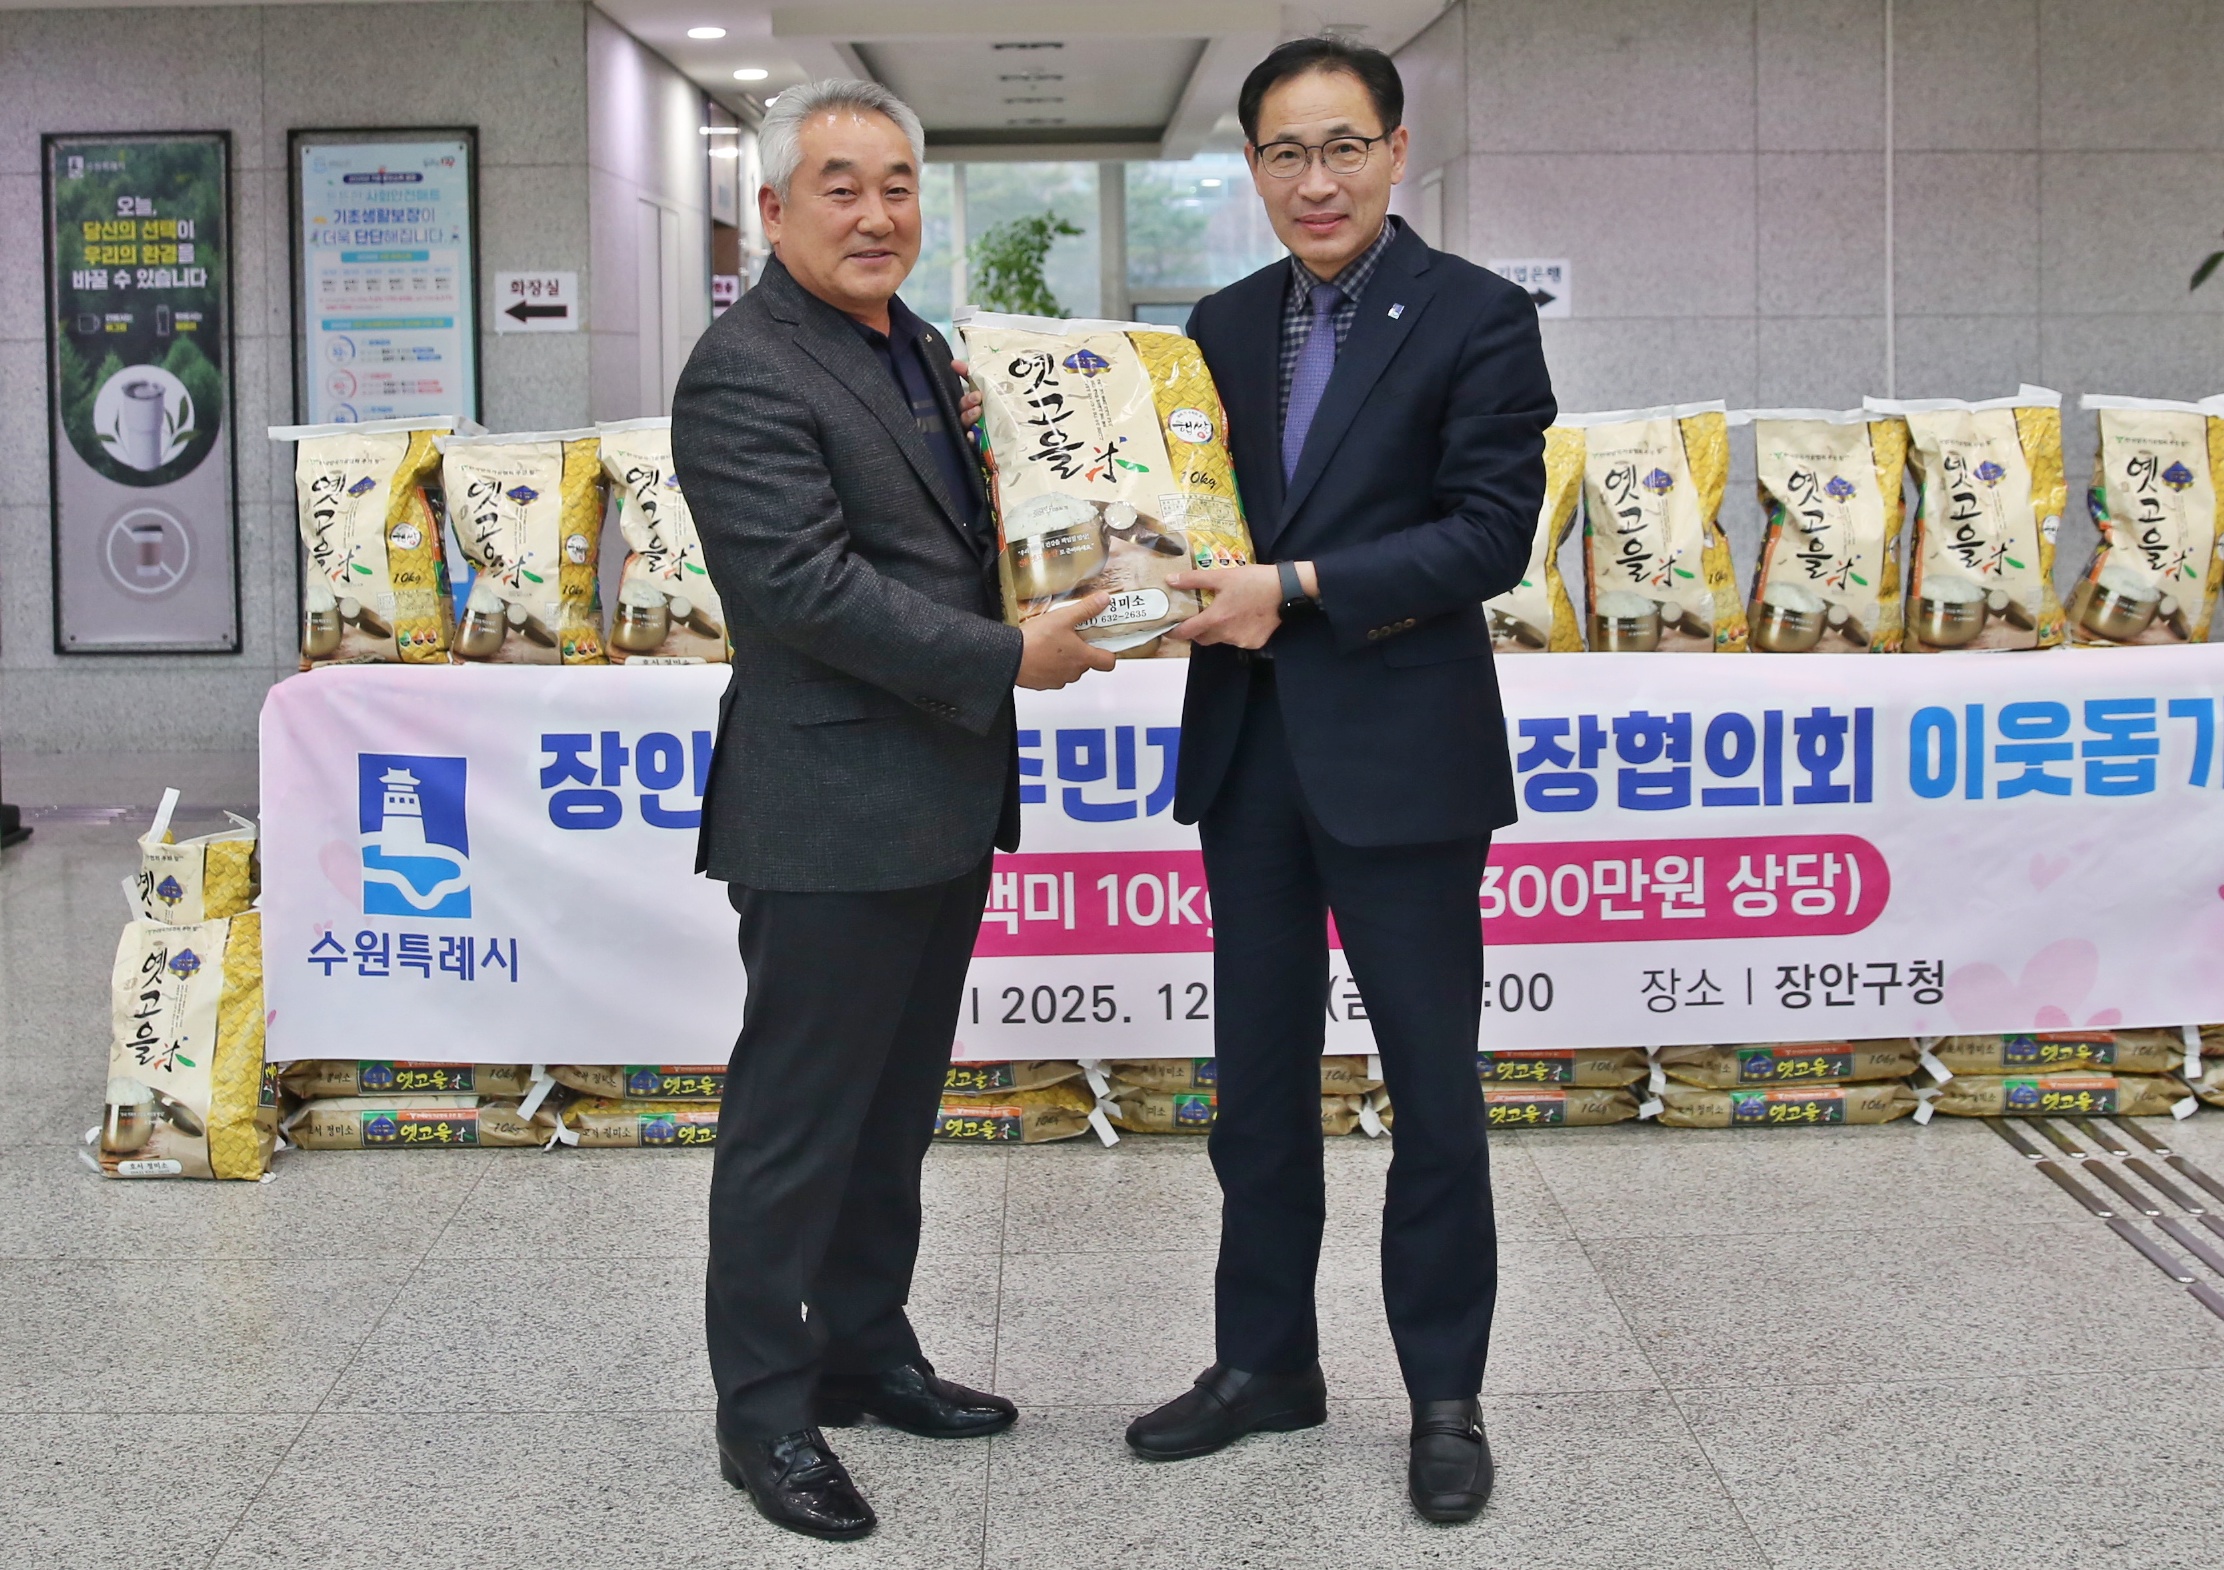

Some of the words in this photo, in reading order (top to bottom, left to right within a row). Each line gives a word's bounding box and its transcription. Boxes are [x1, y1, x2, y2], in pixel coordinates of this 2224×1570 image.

[117, 196, 157, 216] 오늘,
[334, 207, 435, 225] 기초생활보장이
[83, 220, 136, 241] 당신의
[142, 220, 194, 240] 선택이
[323, 230, 350, 246] 더욱
[84, 244, 136, 265] 우리의
[142, 244, 195, 264] 환경을
[72, 270, 108, 290] 바꿀
[114, 271, 132, 290] 수
[136, 268, 207, 289] 있습니다
[510, 279, 560, 296] 화장실
[1008, 348, 1085, 480] 옛고을
[1180, 471, 1217, 489] 10kg
[1605, 464, 1654, 583] 옛고을
[2126, 455, 2169, 571] 옛고을
[1787, 470, 1832, 580] 옛고을
[394, 572, 421, 584] 10kg
[1101, 610, 1147, 623] 632-2635
[539, 730, 713, 831] 장안
[985, 871, 1076, 936] 백미
[1480, 855, 1707, 923] 300만원
[1726, 851, 1863, 919] 상당)
[308, 930, 519, 982] 수원특례시
[1002, 984, 1132, 1025] 2025.
[1640, 966, 1724, 1014] 장소
[1775, 959, 1946, 1010] 장안구청
[126, 945, 168, 1066] 옛고을
[1496, 1061, 1548, 1081] 옛고을
[1776, 1056, 1828, 1080] 옛고을
[1868, 1054, 1896, 1066] 10kg
[396, 1070, 448, 1090] 옛고을
[662, 1075, 716, 1096] 옛고을
[1768, 1101, 1821, 1122] 옛고을
[2040, 1090, 2094, 1112] 옛고을
[1488, 1104, 1542, 1123] 옛고을
[400, 1122, 453, 1143] 옛고을
[946, 1118, 996, 1140] 옛고을
